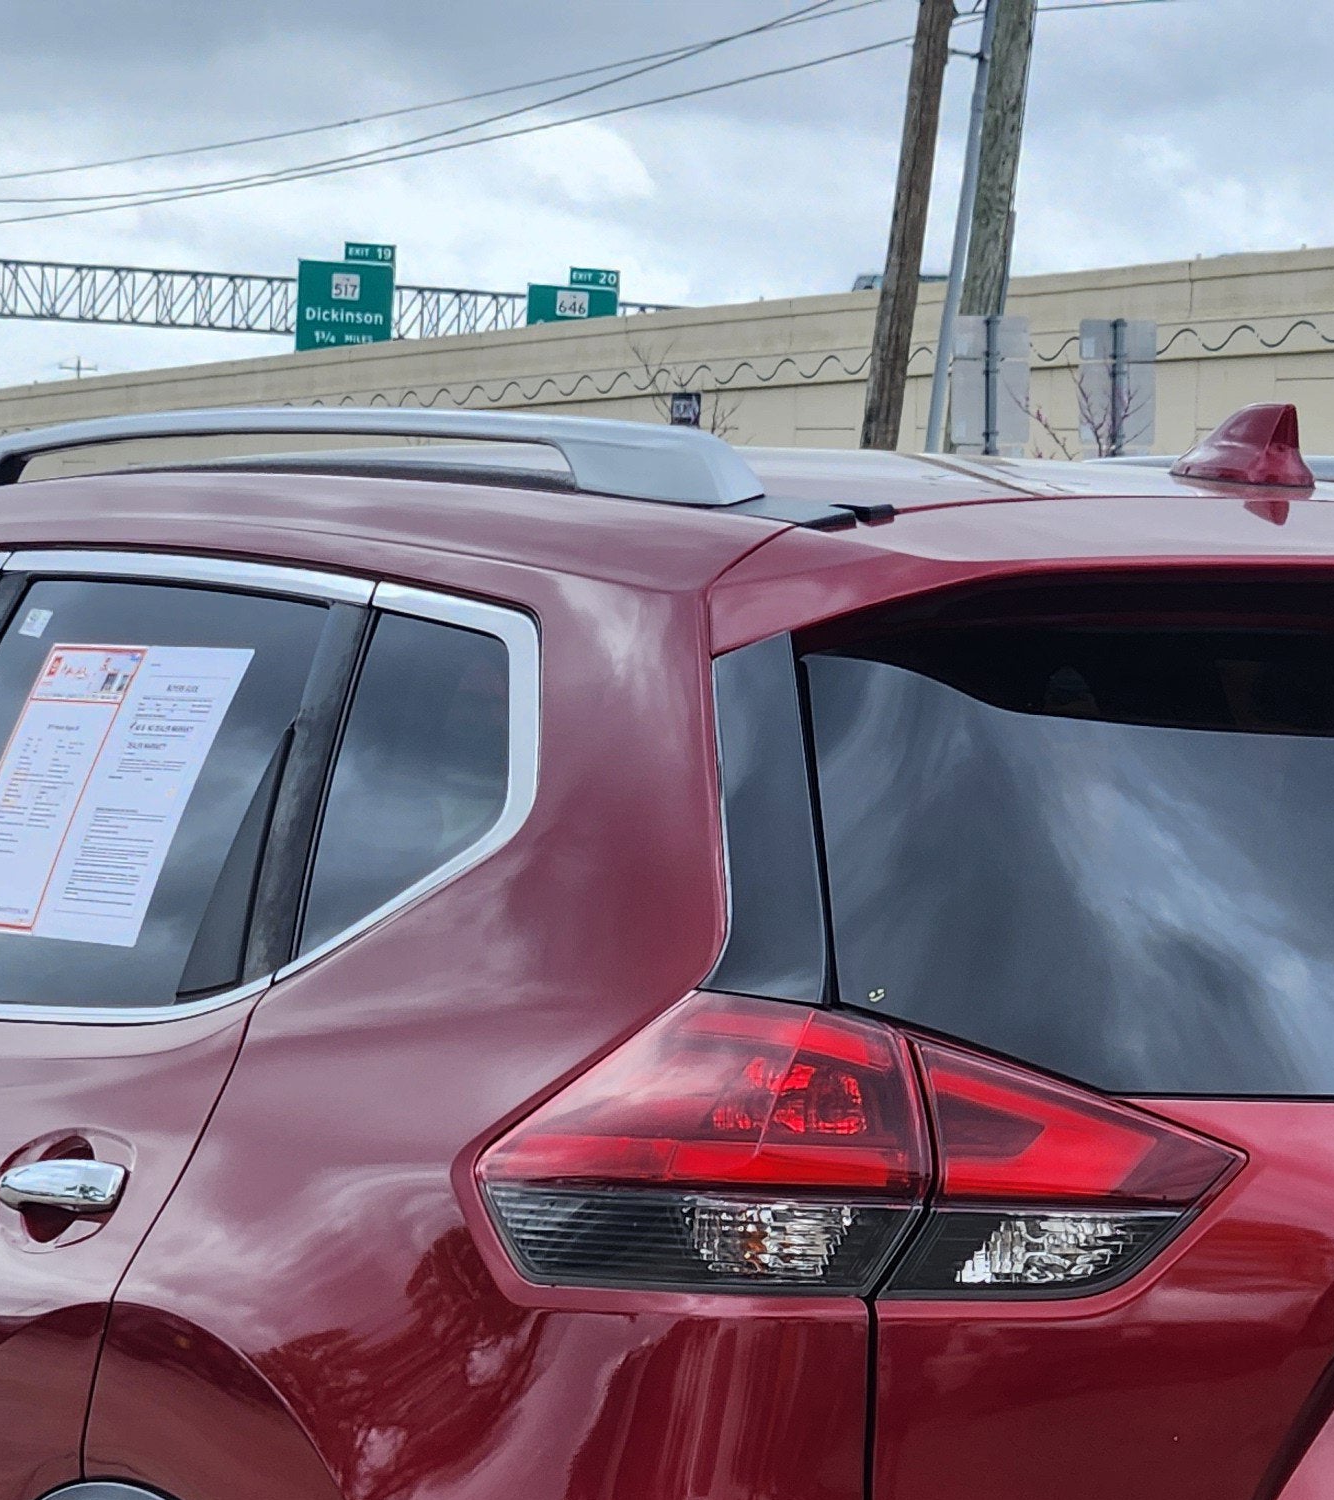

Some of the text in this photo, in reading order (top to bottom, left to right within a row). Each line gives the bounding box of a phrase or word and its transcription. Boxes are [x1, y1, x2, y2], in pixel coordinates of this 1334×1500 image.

[348, 246, 392, 260] EXIT 19
[572, 271, 617, 285] EXIT 20
[334, 283, 358, 298] 517
[558, 300, 586, 315] 646
[305, 306, 383, 325] Dickinson
